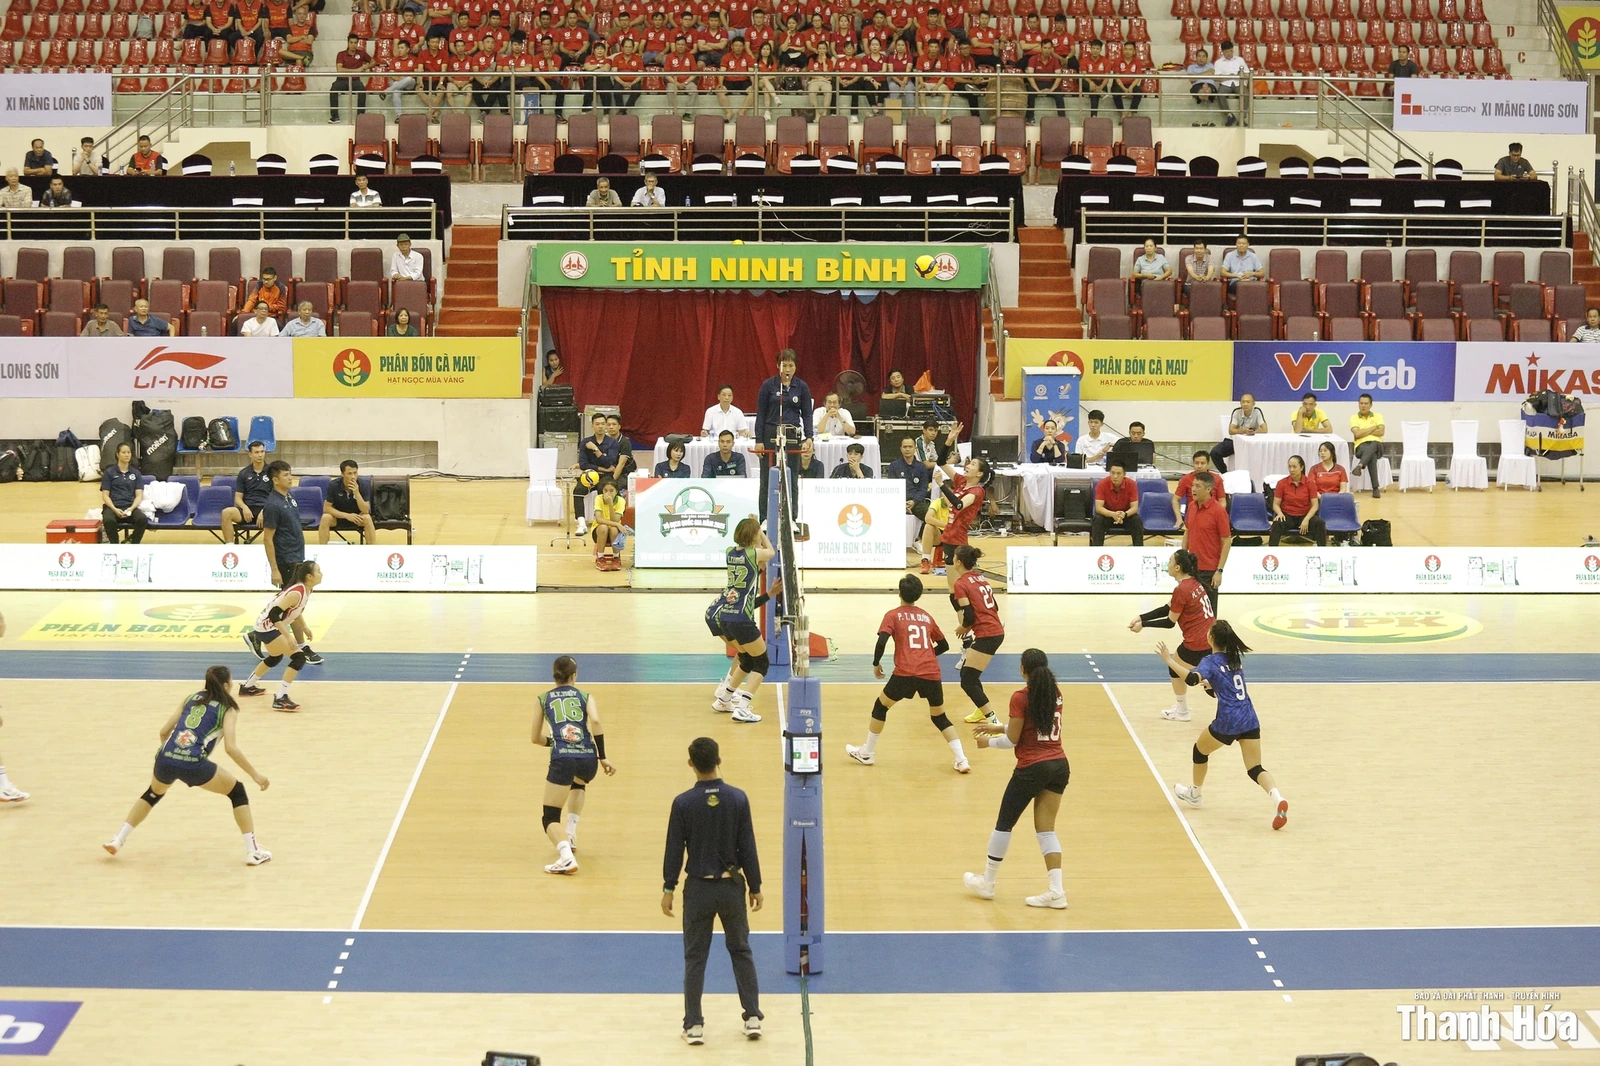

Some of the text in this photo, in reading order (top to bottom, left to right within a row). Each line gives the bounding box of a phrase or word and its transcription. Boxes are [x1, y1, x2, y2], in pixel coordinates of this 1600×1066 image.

[1506, 25, 1515, 38] D
[1517, 51, 1526, 64] C
[6, 94, 104, 111] XI MĂNG LONG SƠN
[1423, 105, 1452, 113] LONG
[1481, 100, 1579, 119] XI MĂNG LONG SƠN
[611, 248, 907, 282] TỈNH NINH BÌNH
[0, 361, 60, 379] LONG SƠN
[379, 353, 476, 373] PHÂN BÓN CÀ MAU
[1093, 355, 1189, 375] PHÂN BÓN CÀ MAU
[133, 375, 228, 389] LI-NING
[402, 376, 425, 385] NGỌC
[443, 375, 465, 384] VÀNG
[1114, 379, 1137, 387] NGỌC
[1156, 378, 1177, 387] VÀNG
[1199, 594, 1215, 619] 10
[1287, 616, 1448, 629] NPK
[907, 624, 929, 649] 21
[1233, 674, 1246, 701] 9
[184, 704, 207, 729] 8
[550, 697, 583, 723] 16
